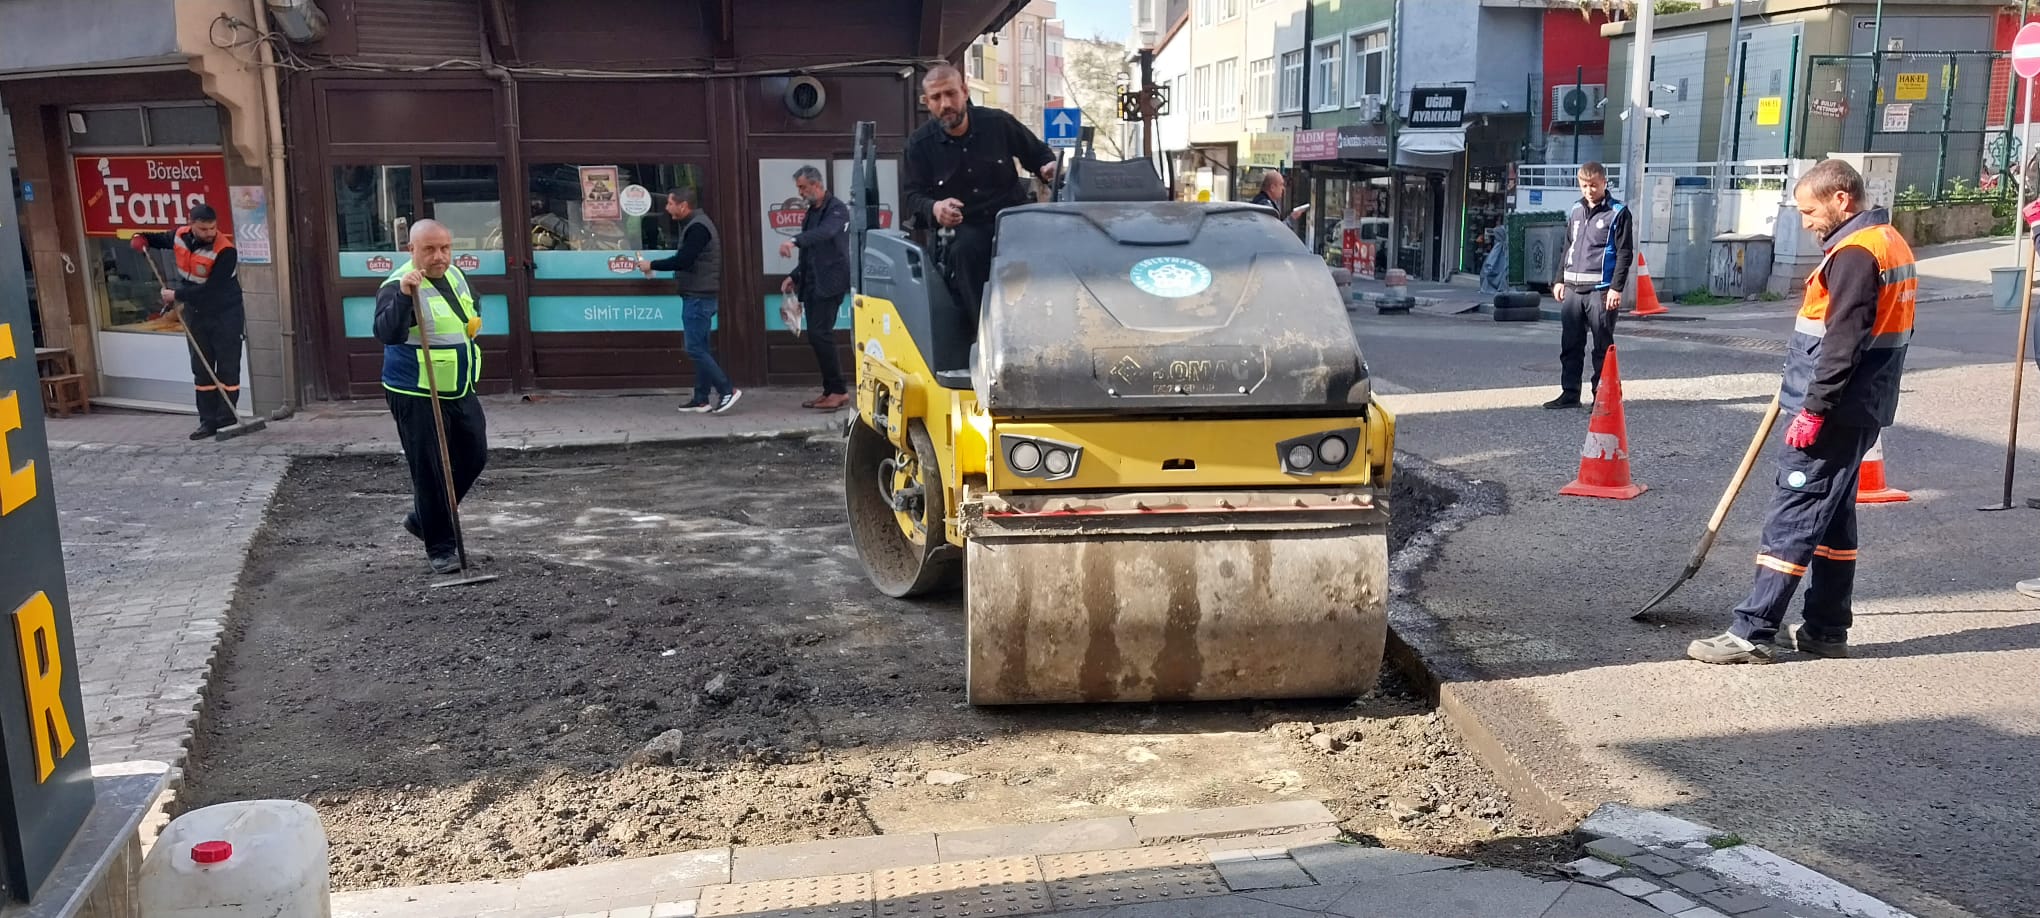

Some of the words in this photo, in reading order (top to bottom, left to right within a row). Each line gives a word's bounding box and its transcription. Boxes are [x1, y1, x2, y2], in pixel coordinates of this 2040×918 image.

[1425, 94, 1453, 108] UĞUR
[1411, 110, 1462, 122] AYAKKABI
[147, 160, 203, 182] Börekçi
[776, 211, 807, 225] ÖKTE
[584, 305, 620, 320] SİMİT
[624, 305, 663, 320] PİZZA
